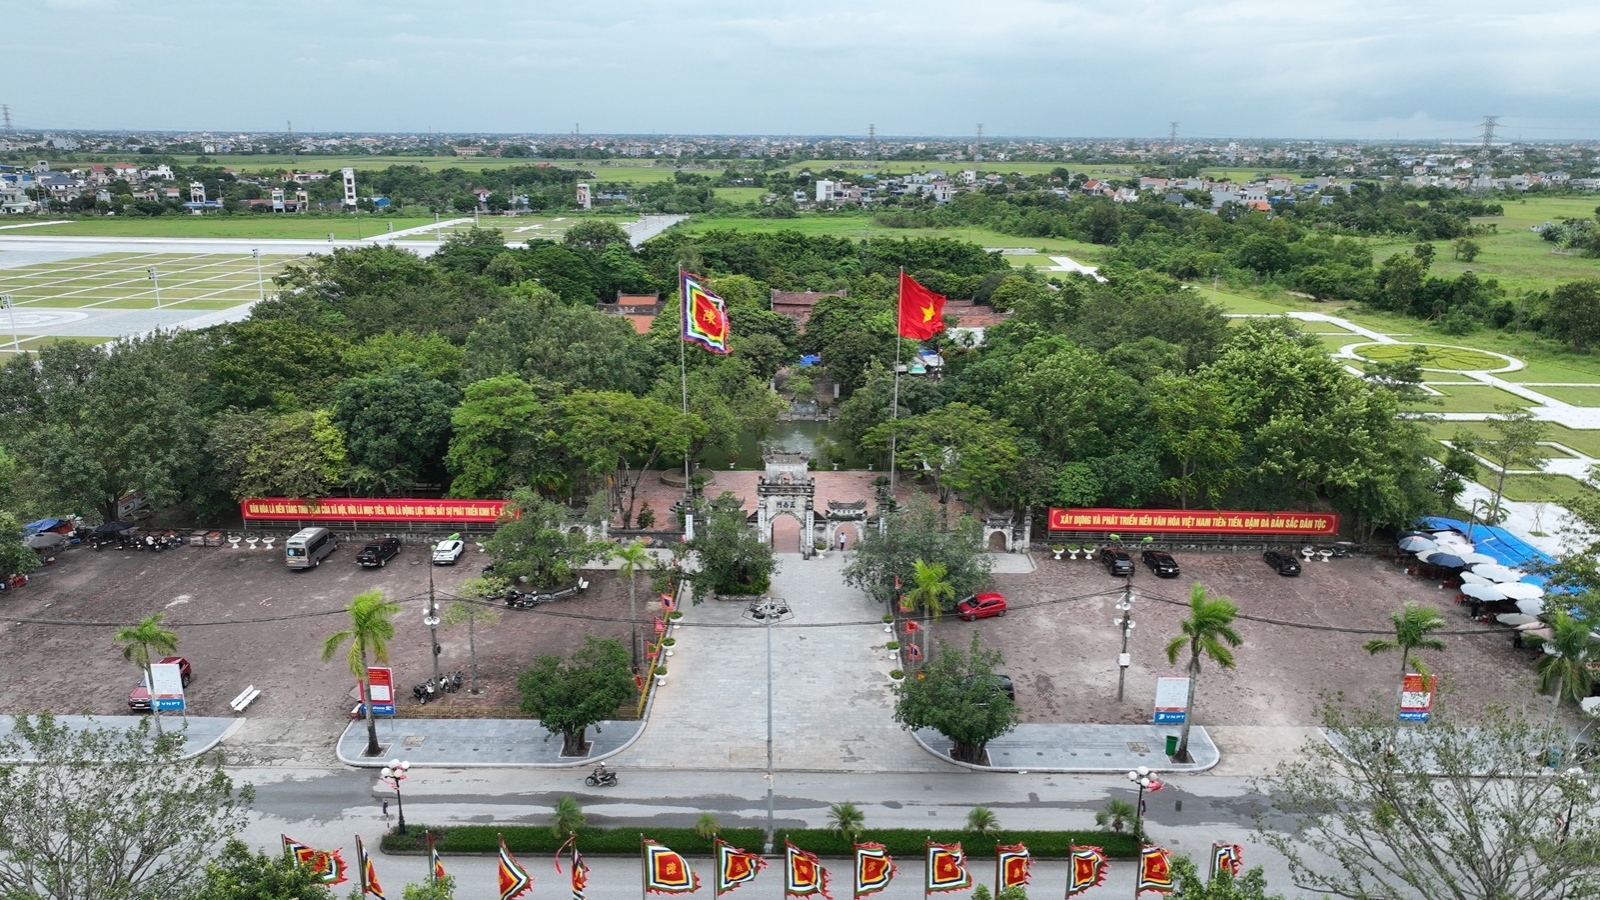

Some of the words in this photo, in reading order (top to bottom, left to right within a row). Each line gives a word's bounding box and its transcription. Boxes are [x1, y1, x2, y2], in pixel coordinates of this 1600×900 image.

[269, 503, 275, 513] LÀ
[357, 504, 363, 515] LÀ
[395, 505, 402, 515] LÀ
[1060, 513, 1073, 524] XÂY
[1073, 514, 1091, 526] DỰNG
[1092, 513, 1101, 524] VÀ
[1102, 514, 1118, 525] PHÁT
[1119, 513, 1138, 525] TRIỂN
[1138, 514, 1152, 526] NỀN
[1153, 515, 1167, 526] VĂN
[1167, 515, 1180, 526] HÓA
[1181, 515, 1195, 528] VIỆT
[1196, 517, 1211, 527] NAM
[1228, 516, 1243, 528] TIẾN,
[1245, 517, 1260, 529] ĐẬM
[1261, 517, 1270, 527] ĐÀ
[1270, 516, 1285, 528] BẢN
[1285, 516, 1298, 528] SẮC
[1299, 518, 1313, 528] DÂN
[1314, 518, 1327, 531] TỘC
